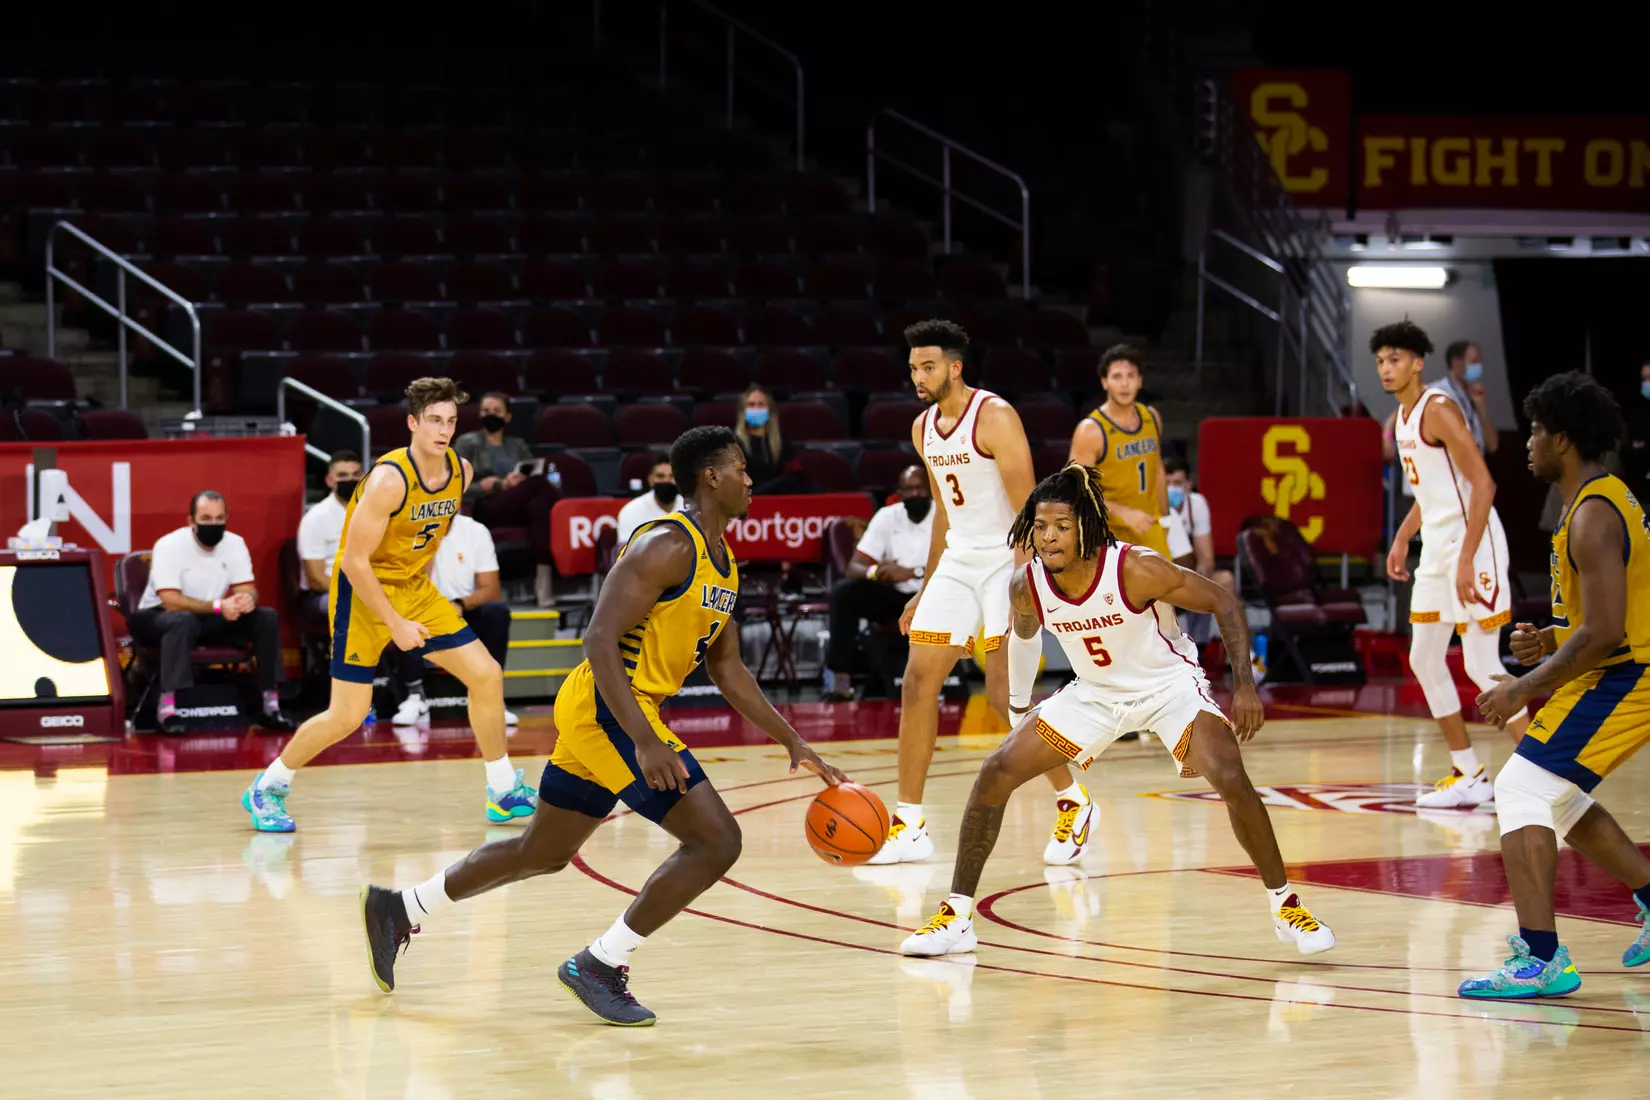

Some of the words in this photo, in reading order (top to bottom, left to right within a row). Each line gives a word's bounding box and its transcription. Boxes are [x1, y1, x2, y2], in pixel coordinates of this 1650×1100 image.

[1362, 135, 1567, 188] FIGHT
[927, 452, 971, 467] TROJANS
[945, 471, 966, 508] 3
[1136, 459, 1148, 495] 1
[410, 497, 459, 522] LANCERS
[410, 521, 443, 552] 5
[726, 511, 842, 549] Mortga
[1052, 612, 1125, 634] TROJANS
[1081, 635, 1113, 668] 5
[40, 715, 85, 728] GEICO
